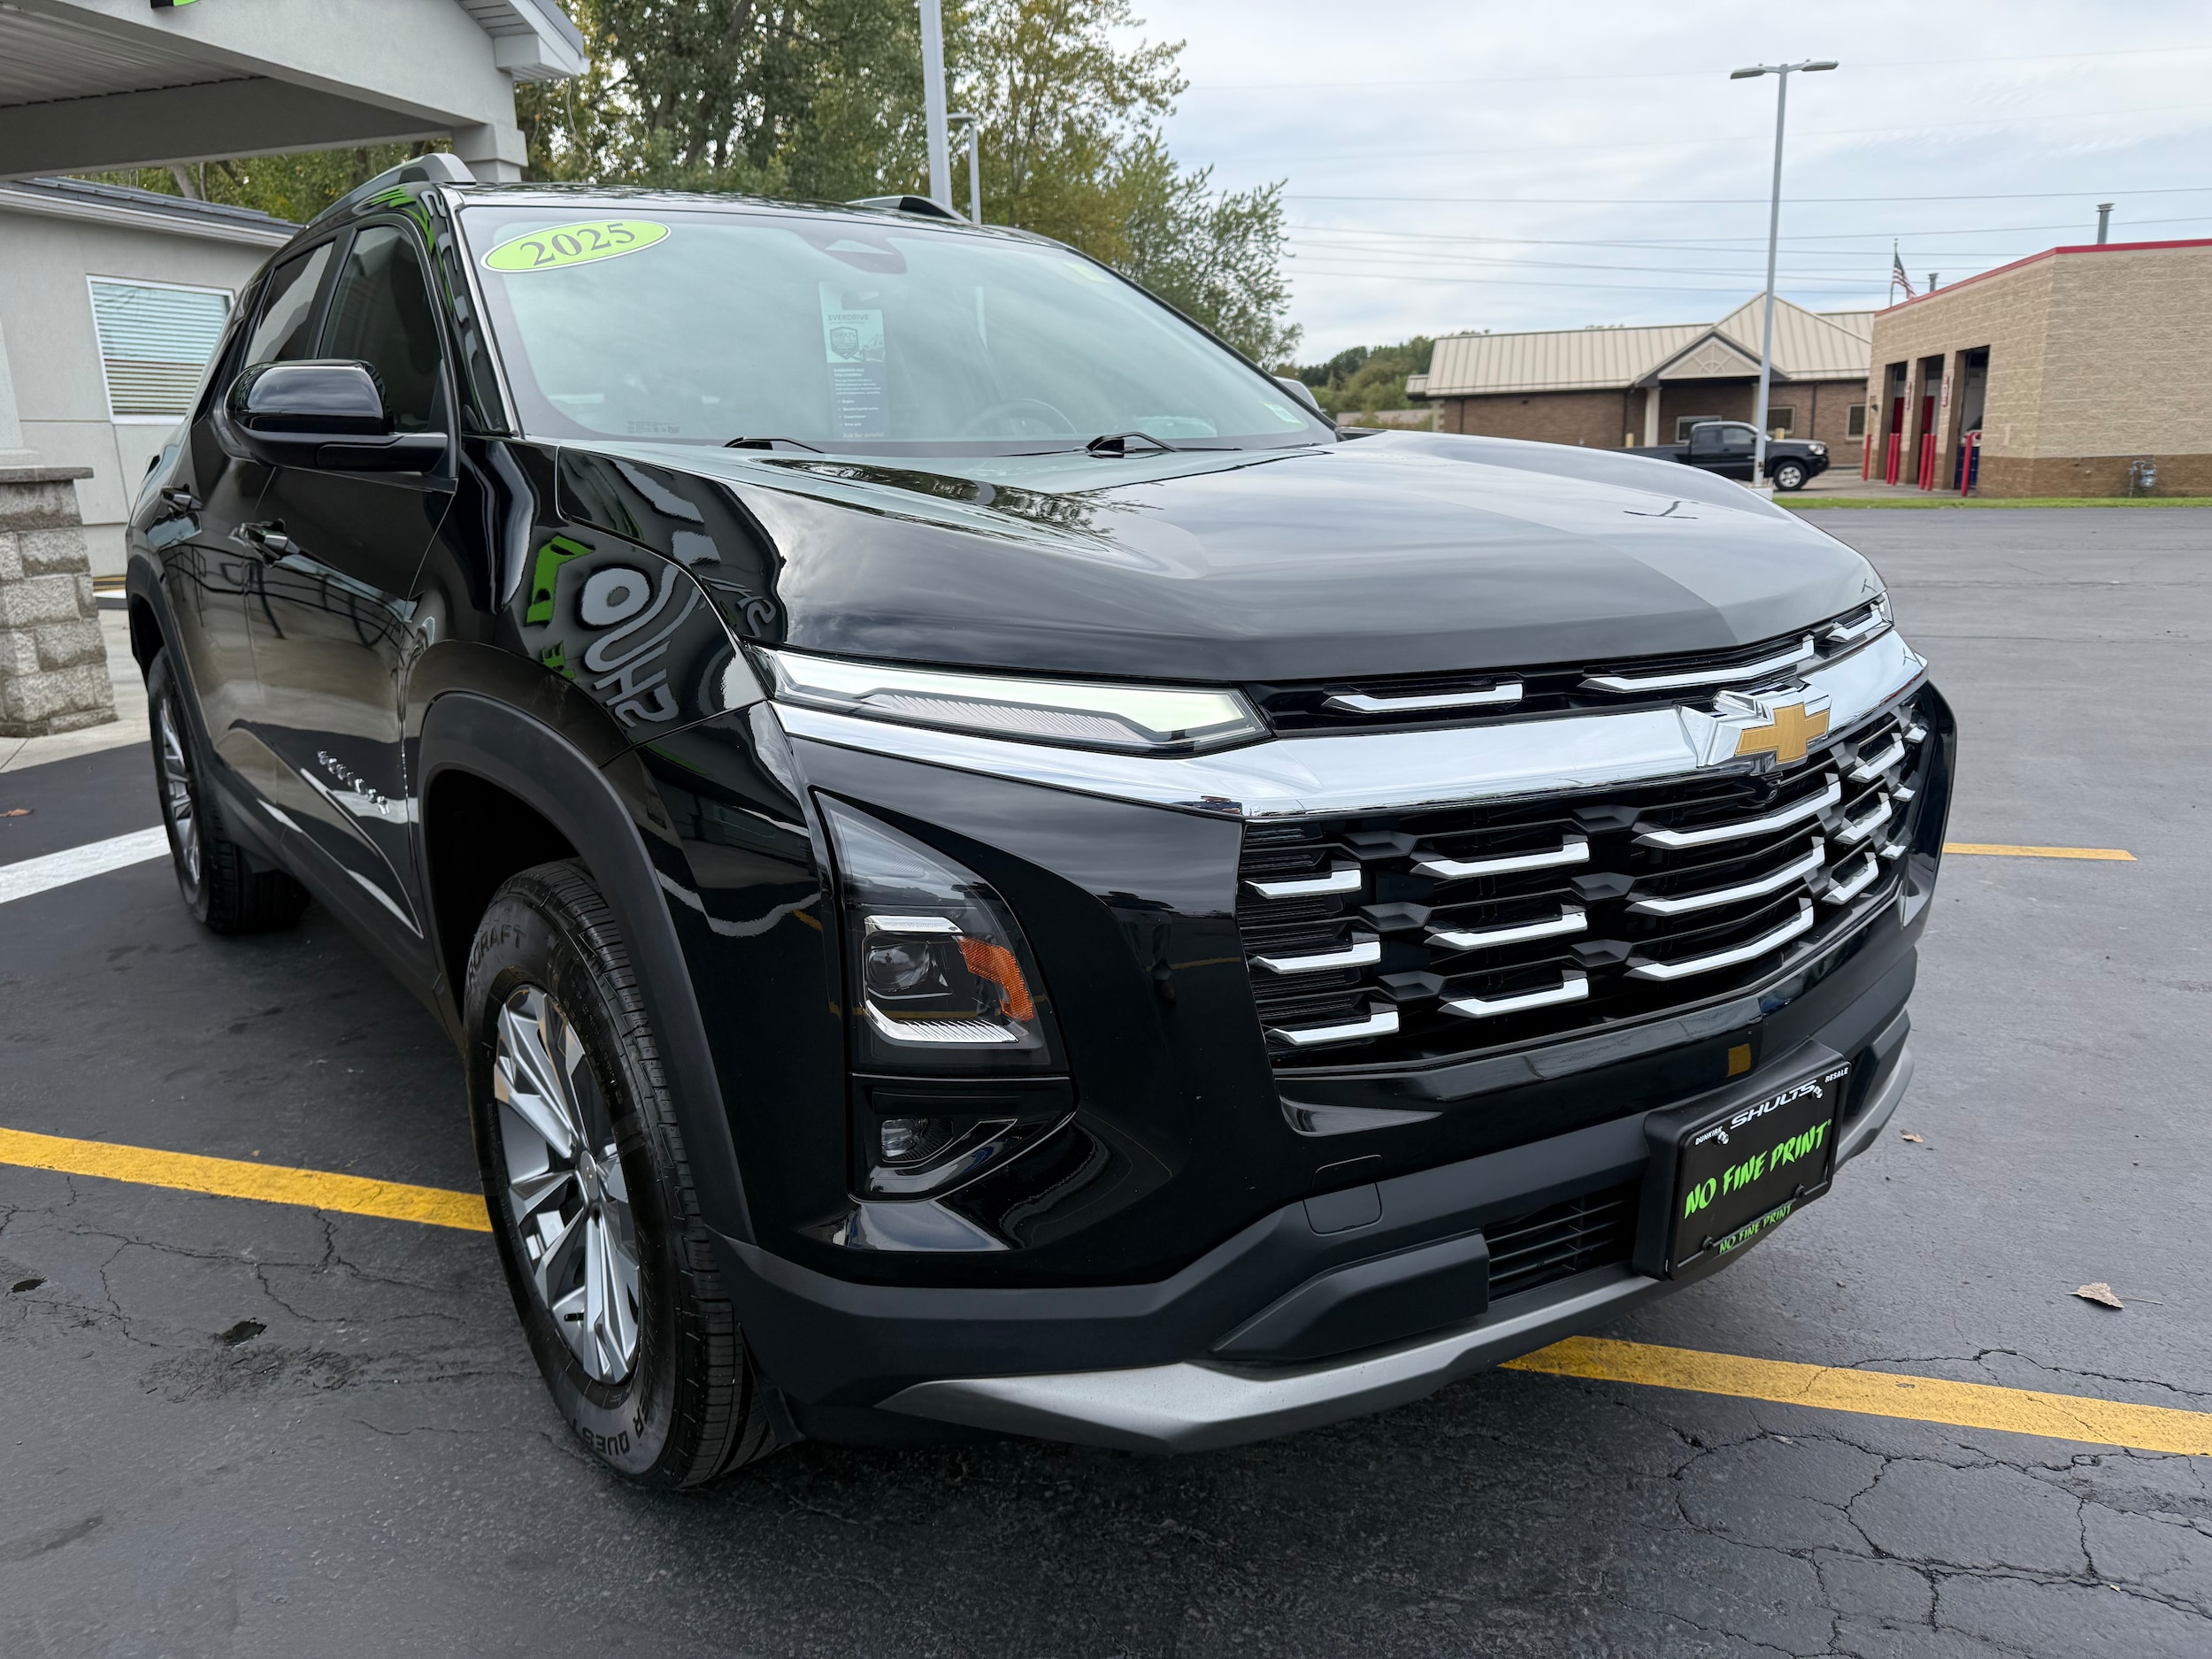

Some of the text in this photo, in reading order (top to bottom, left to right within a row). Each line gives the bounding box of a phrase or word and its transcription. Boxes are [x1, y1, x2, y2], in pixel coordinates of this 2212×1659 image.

[520, 222, 636, 266] 2025
[1824, 1067, 1849, 1084] RESALE
[1730, 1079, 1816, 1130] SHULTS
[1694, 1125, 1724, 1146] DUNKIRK
[1684, 1177, 1717, 1220] NO
[1723, 1150, 1768, 1196] FINE
[1718, 1202, 1793, 1255] NO FINE PRINT
